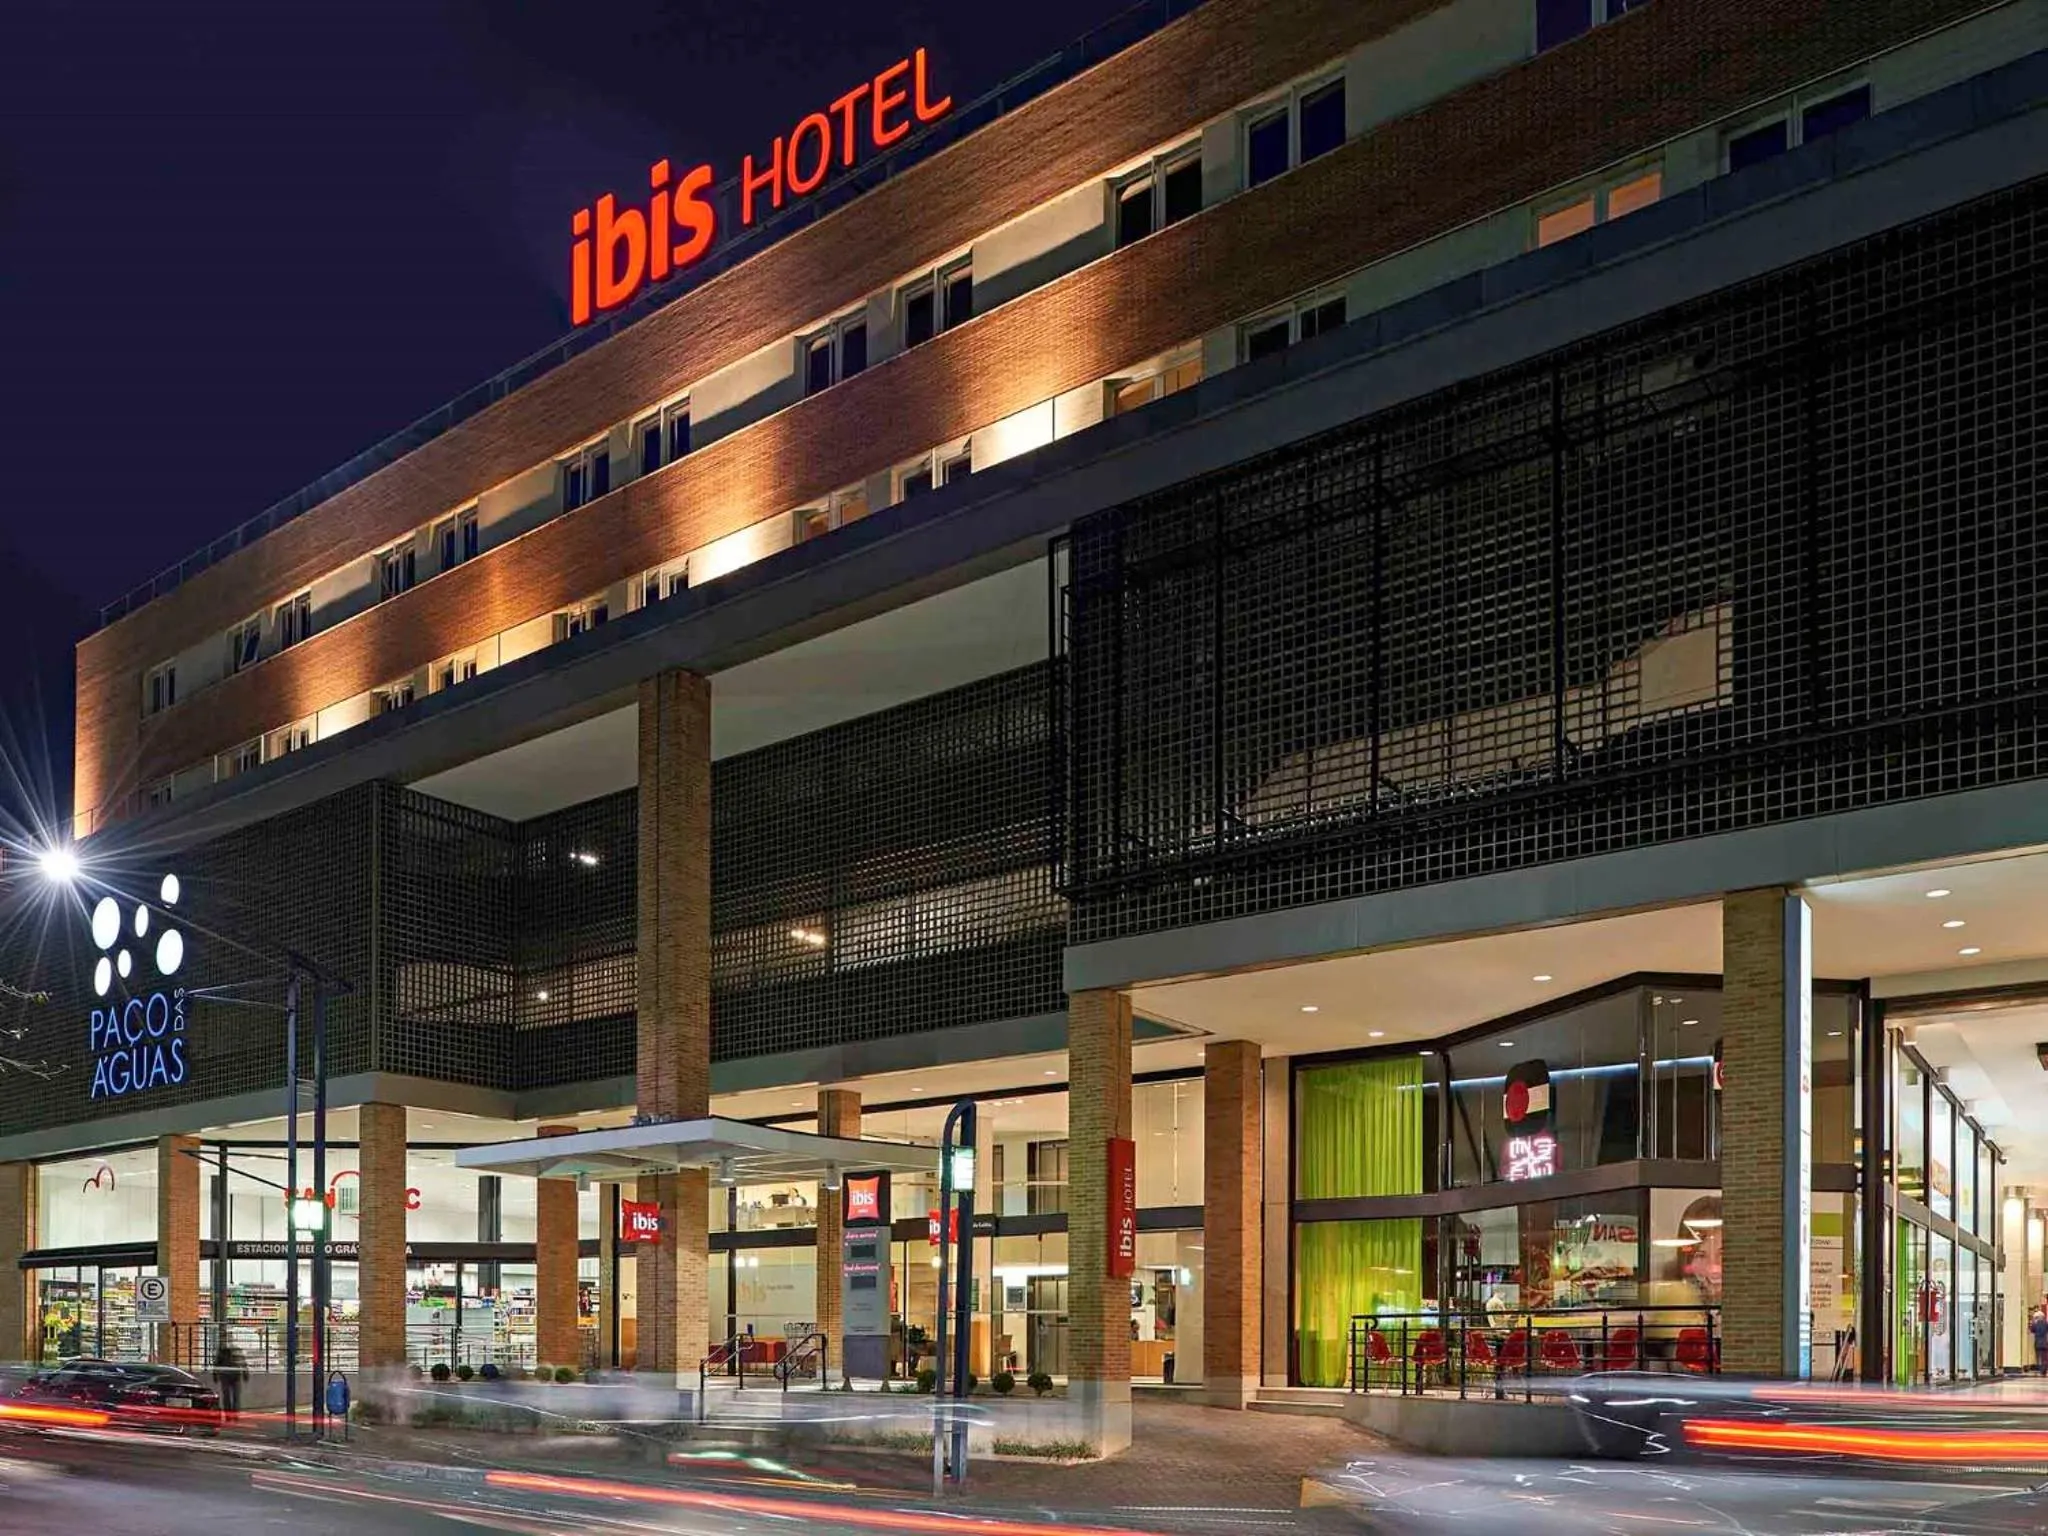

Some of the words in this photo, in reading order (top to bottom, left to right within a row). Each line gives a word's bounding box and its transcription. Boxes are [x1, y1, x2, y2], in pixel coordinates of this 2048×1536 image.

[571, 159, 716, 326] ibis
[741, 47, 952, 225] HOTEL
[91, 991, 169, 1051] PAÇO
[174, 986, 185, 1032] DAS
[91, 1037, 184, 1099] ÁGUAS
[851, 1190, 875, 1206] ibis
[1123, 1167, 1133, 1212] HOTEL
[632, 1211, 658, 1231] ibis
[1120, 1217, 1133, 1256] ibis
[237, 1244, 333, 1255] ESTACIONMEO
[147, 1283, 158, 1296] E
